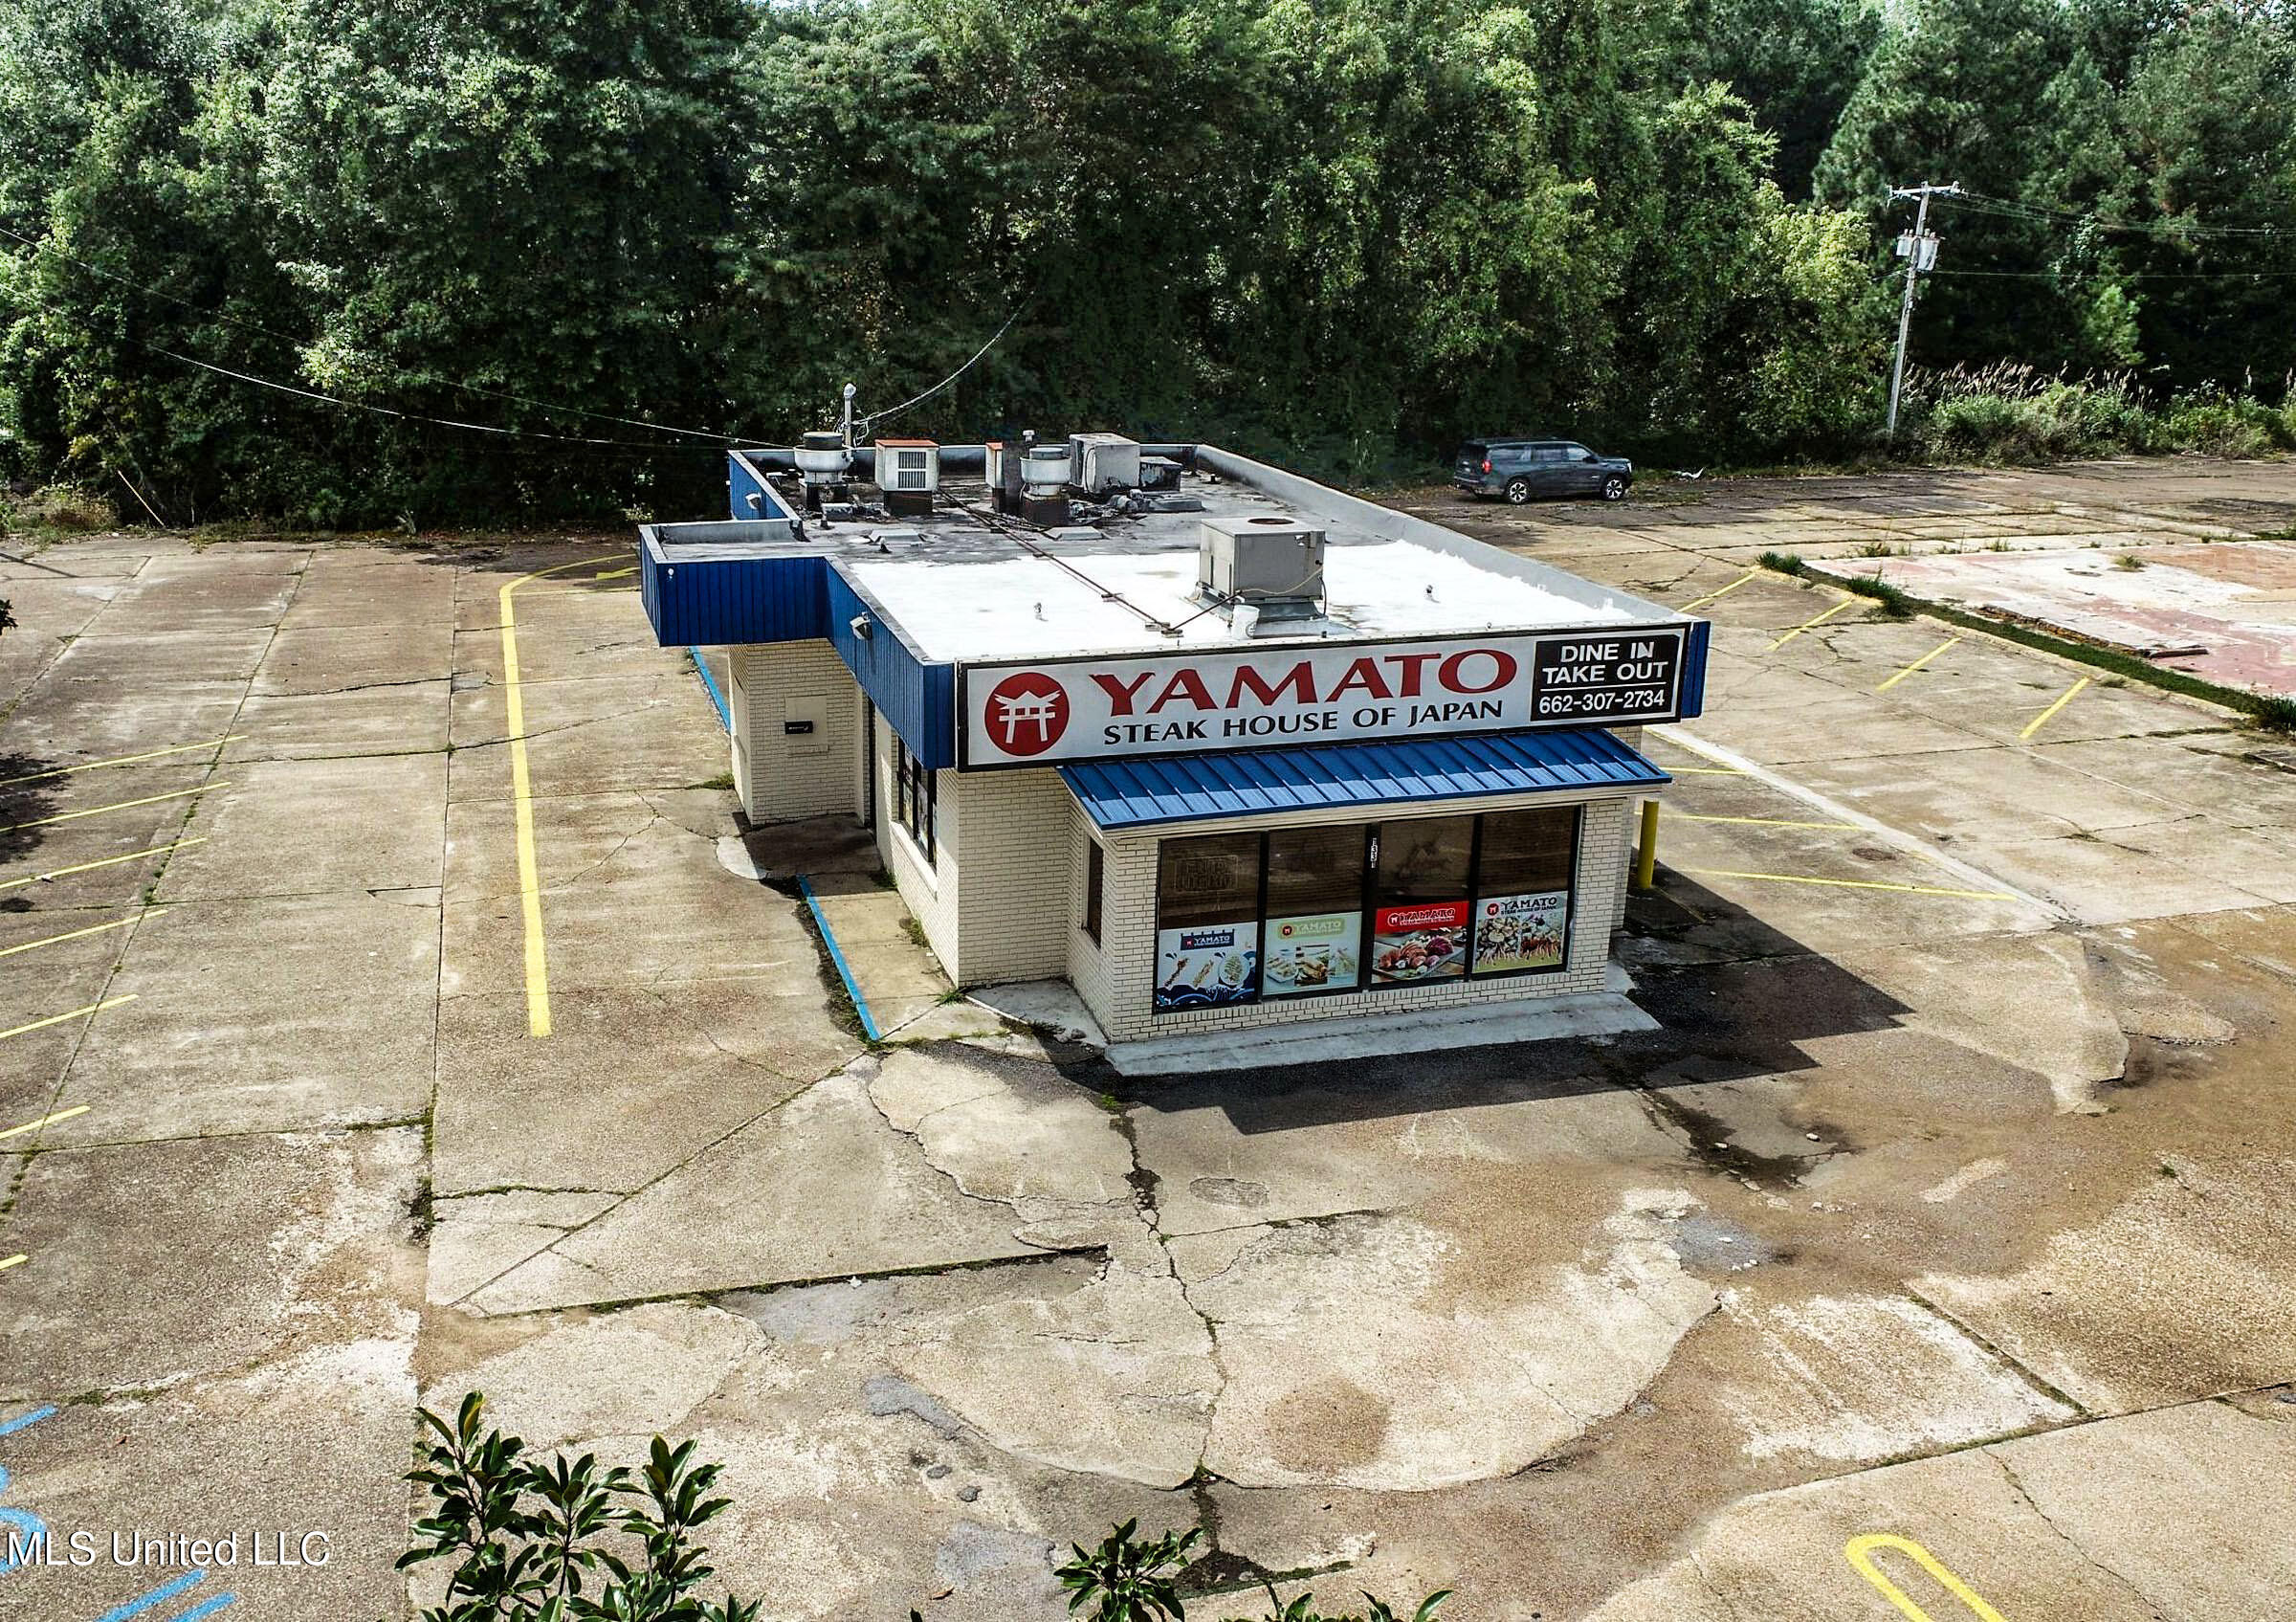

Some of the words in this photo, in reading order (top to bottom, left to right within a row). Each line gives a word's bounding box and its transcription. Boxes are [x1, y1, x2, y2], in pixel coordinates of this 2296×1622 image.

[1560, 643, 1620, 663] DINE
[1630, 641, 1655, 659] IN
[1089, 649, 1518, 717] YAMATO
[1542, 664, 1605, 684] TAKE
[1617, 661, 1668, 680] OUT
[1538, 689, 1666, 715] 662-307-2734
[1103, 719, 1207, 745] STEAK
[1223, 711, 1337, 738] HOUSE
[1353, 707, 1396, 727] OF
[1408, 700, 1503, 727] JAPAN
[1400, 908, 1456, 921] YAMATO
[1501, 897, 1556, 910] YAMATO
[1194, 935, 1230, 944] YAMATO
